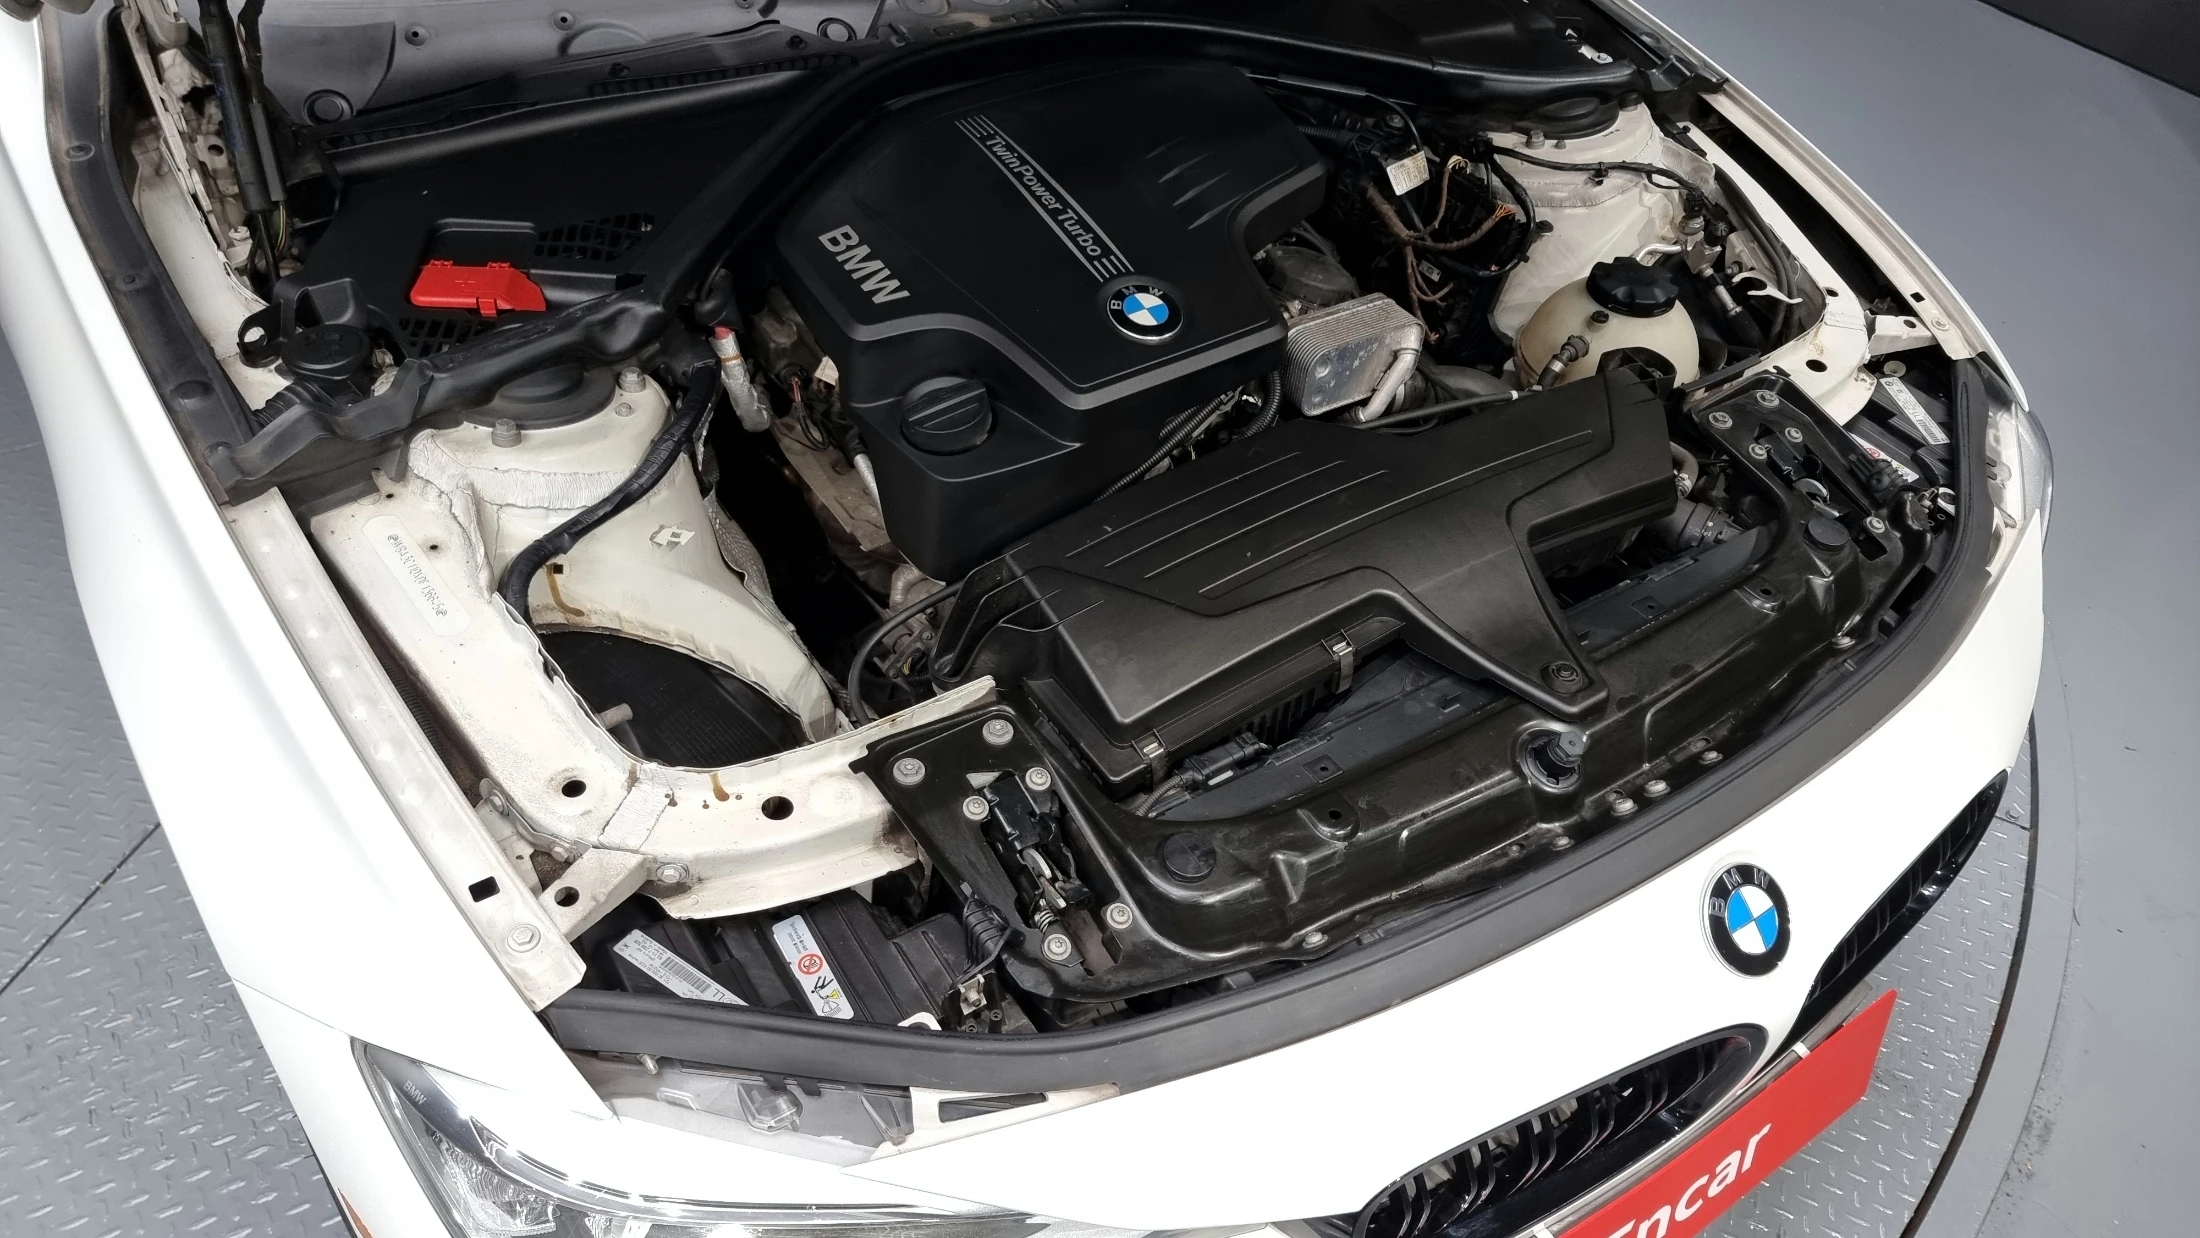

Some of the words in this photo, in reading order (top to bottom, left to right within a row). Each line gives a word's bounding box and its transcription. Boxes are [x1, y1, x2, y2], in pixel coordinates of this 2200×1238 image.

[986, 135, 1063, 210] TwinPower
[1057, 208, 1102, 257] Turbo
[818, 225, 911, 304] BMW
[1110, 286, 1164, 311] BMW
[1708, 867, 1771, 918] BMW
[403, 1080, 427, 1105] BMW
